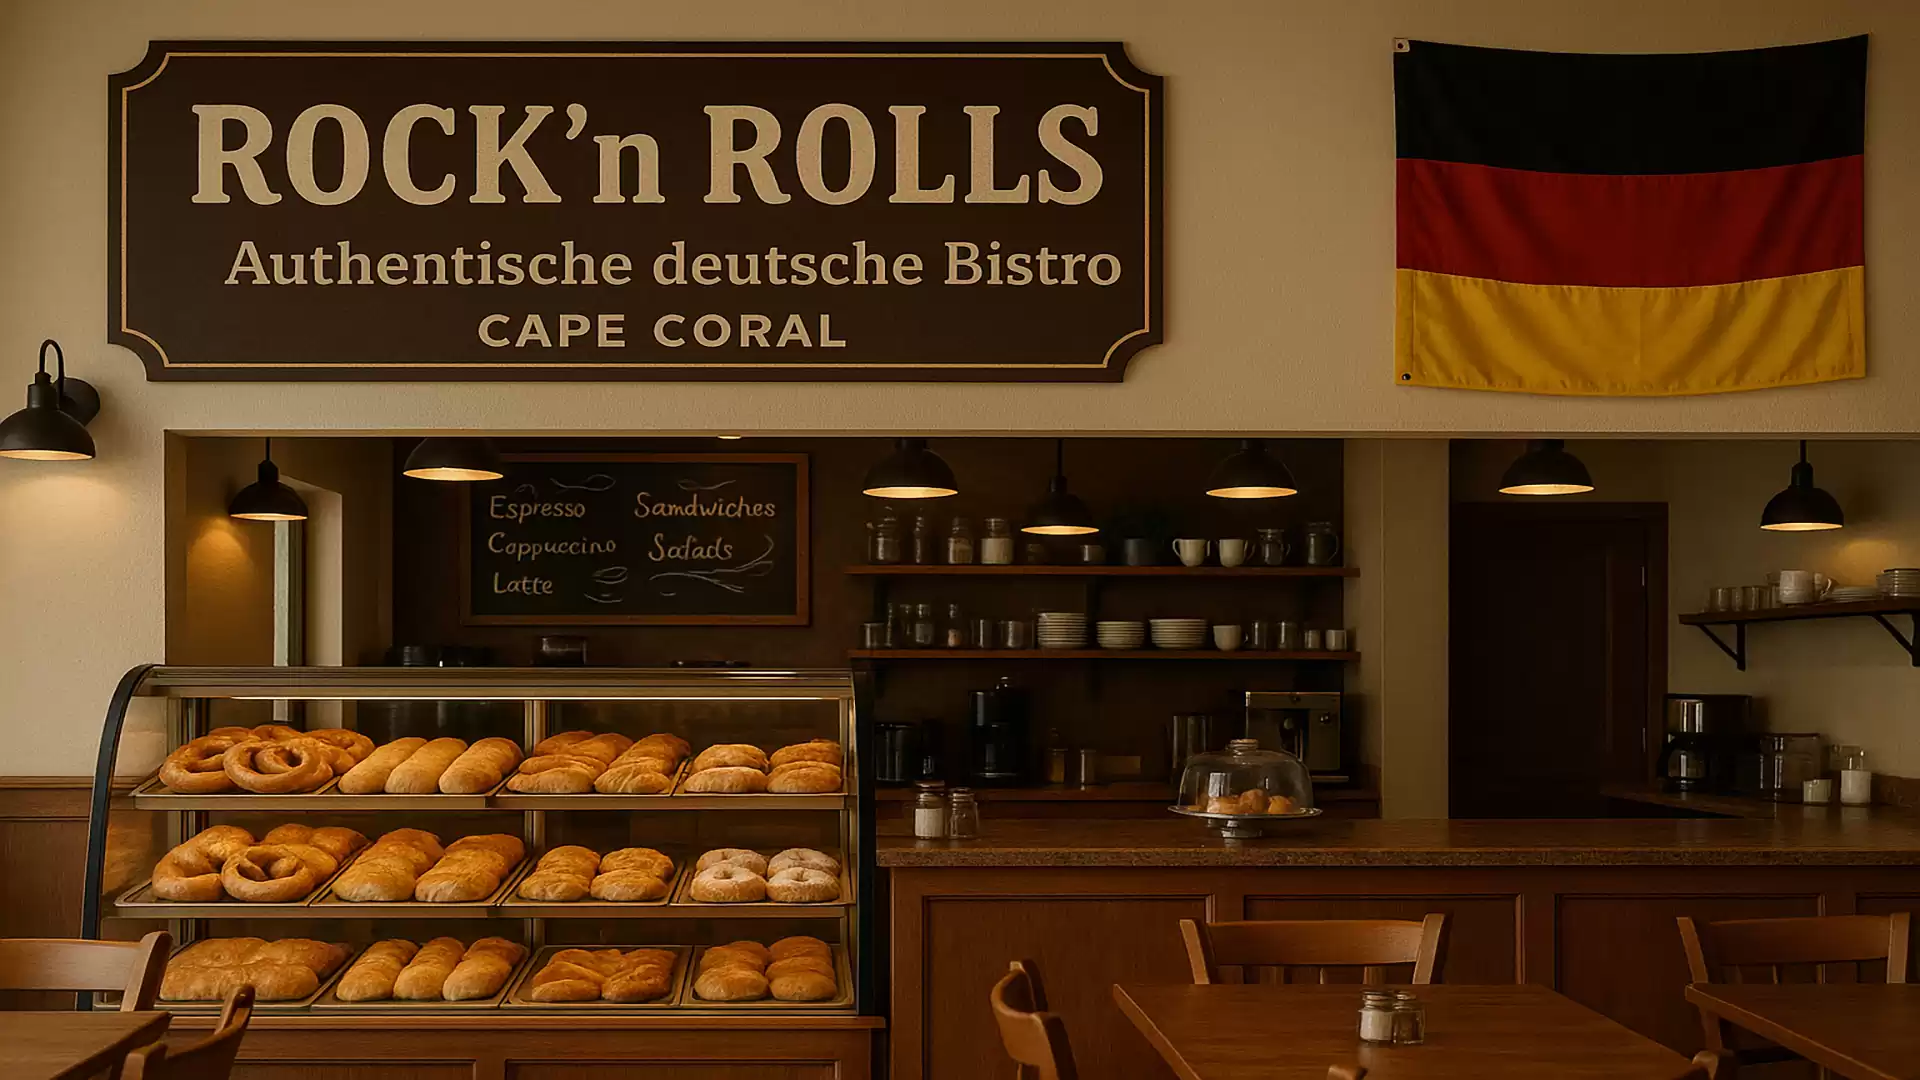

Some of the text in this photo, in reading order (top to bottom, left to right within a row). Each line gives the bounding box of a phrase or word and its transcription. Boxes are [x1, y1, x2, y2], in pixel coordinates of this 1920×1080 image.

[703, 103, 1103, 206] ROLLS
[224, 240, 1121, 286] Authentische deutsche Bistro
[478, 313, 846, 348] CAPE CORAL
[490, 495, 585, 523] Espresso
[488, 531, 616, 561] Cappuccino
[493, 572, 553, 595] Latte
